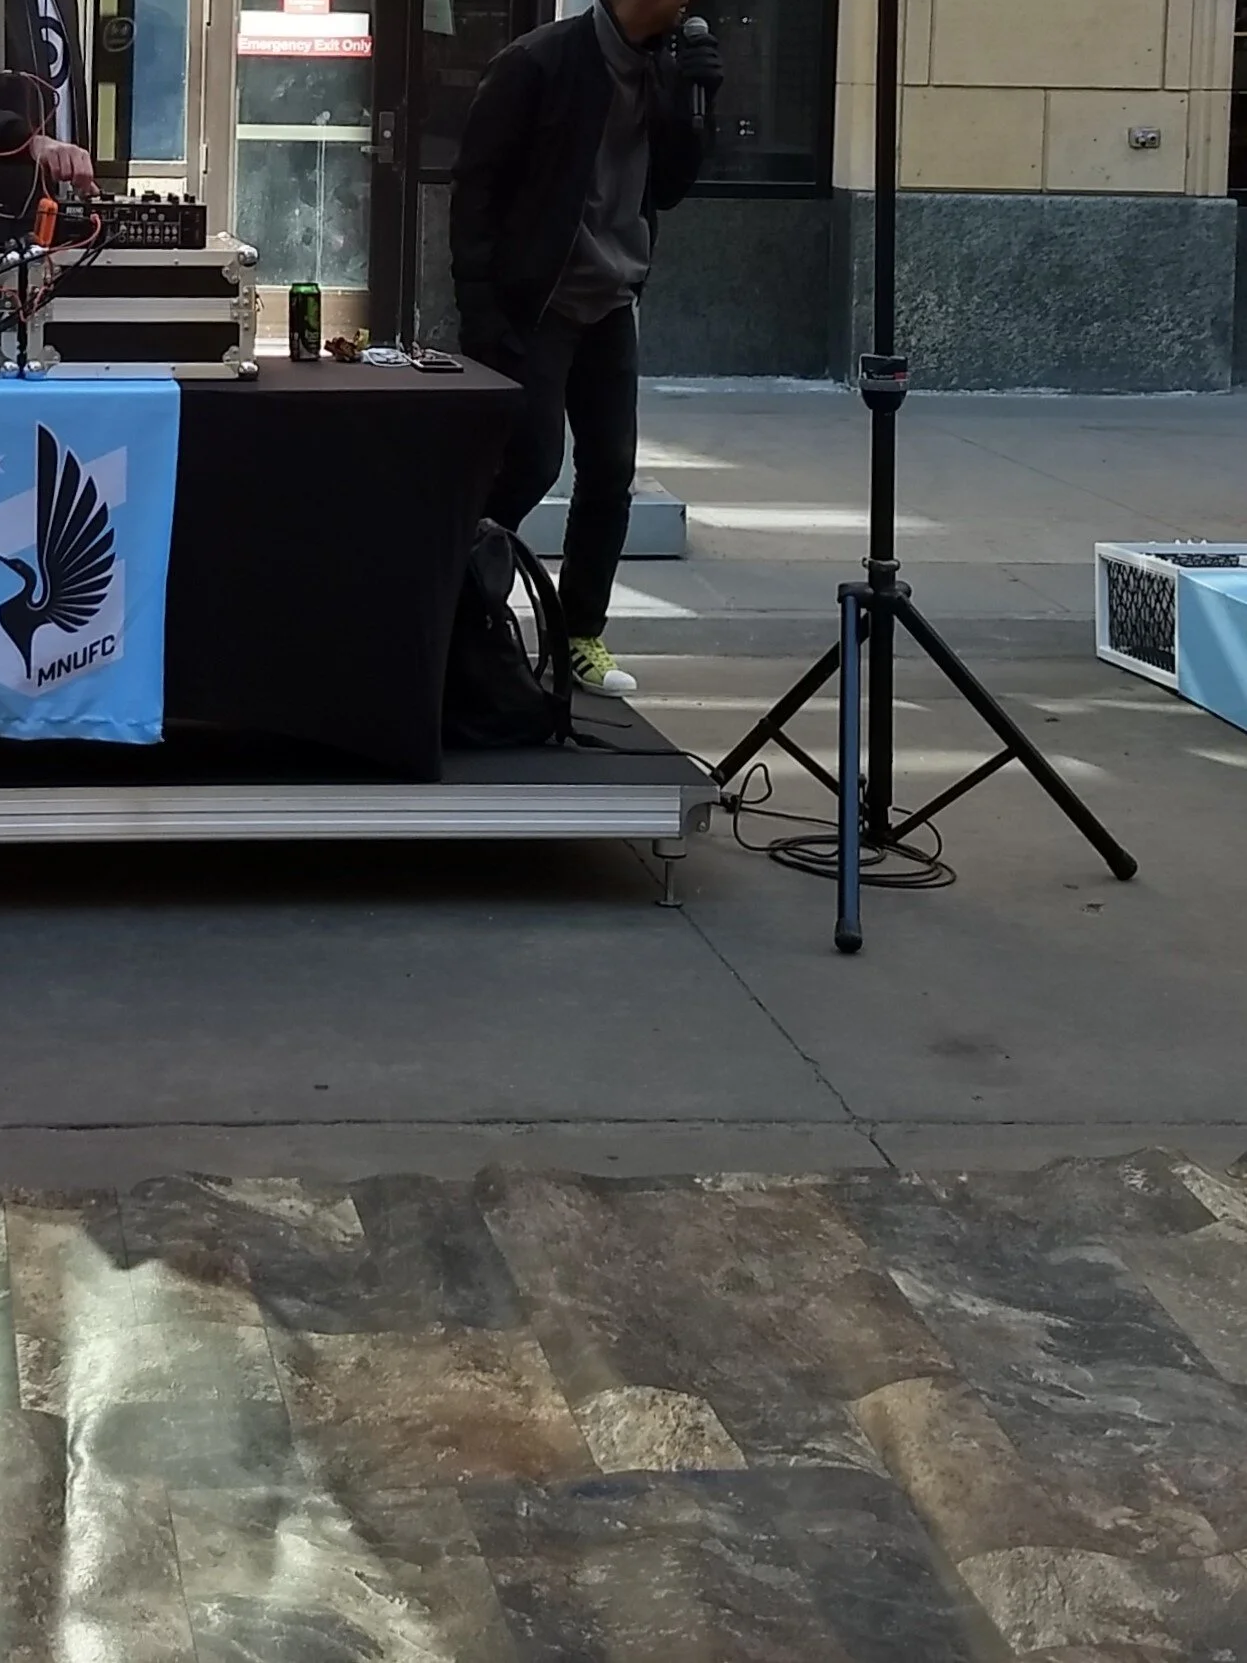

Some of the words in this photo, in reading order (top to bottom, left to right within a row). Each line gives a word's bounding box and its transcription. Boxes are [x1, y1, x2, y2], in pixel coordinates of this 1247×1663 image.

[239, 38, 313, 53] Emergency
[314, 39, 340, 51] Exit
[342, 39, 372, 53] Only
[37, 634, 116, 688] MNUFC
